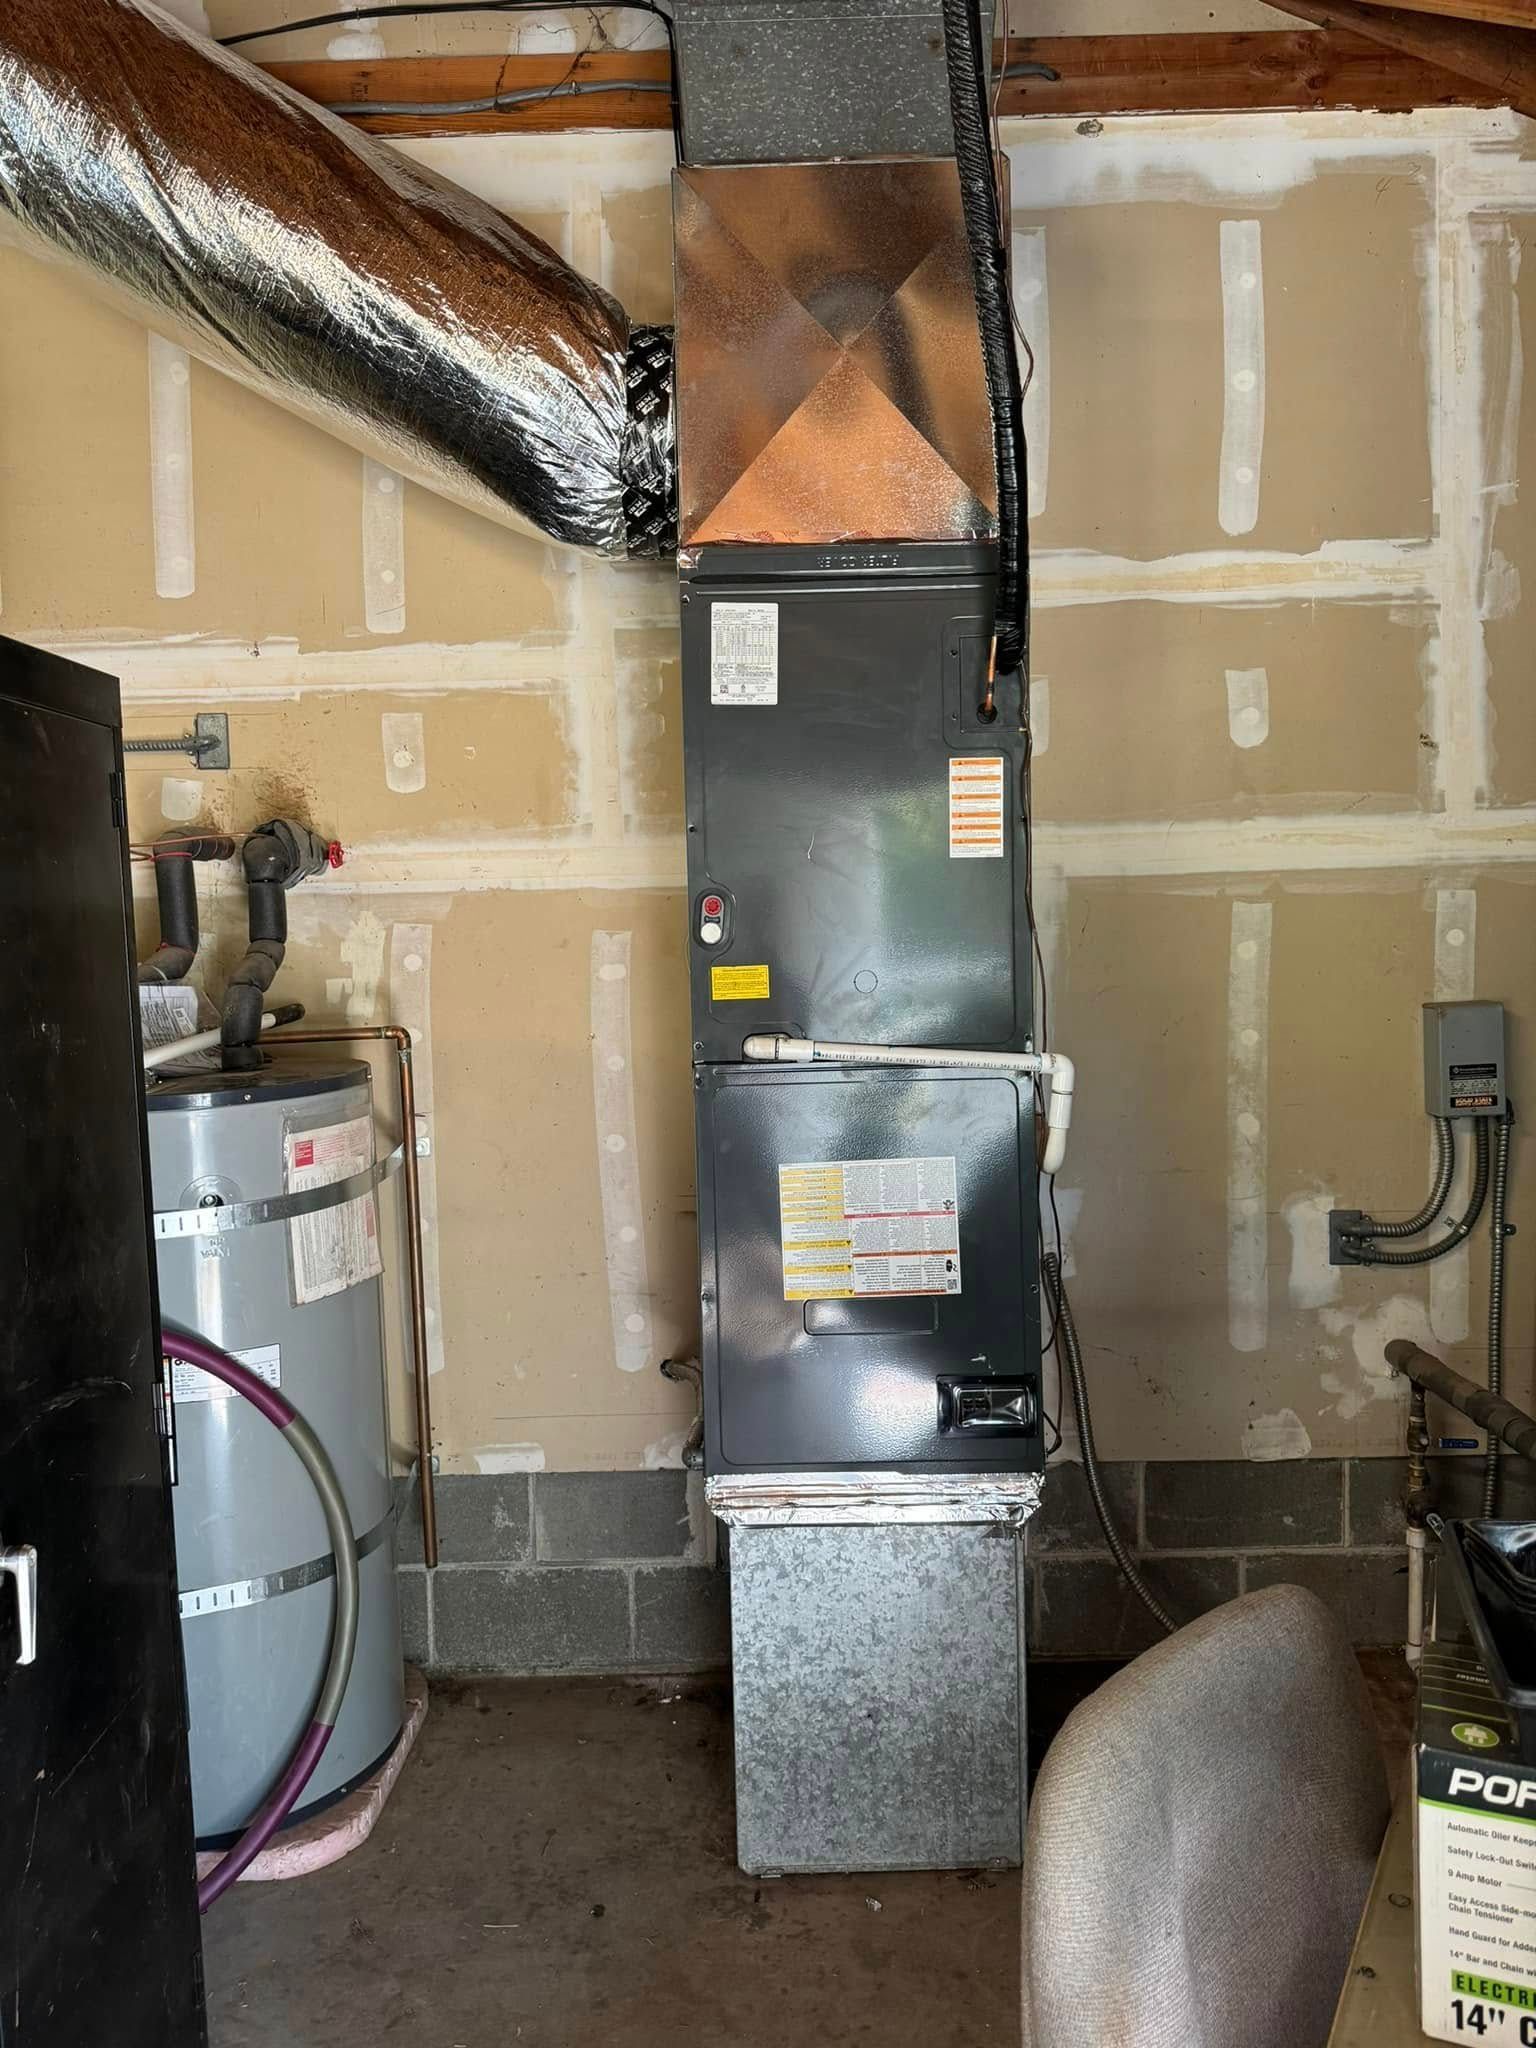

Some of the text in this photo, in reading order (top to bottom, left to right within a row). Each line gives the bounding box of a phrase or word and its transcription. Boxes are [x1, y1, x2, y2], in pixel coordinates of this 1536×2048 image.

[1447, 1822, 1489, 1838] Automatic
[1491, 1828, 1511, 1841] Oiler
[1447, 1846, 1473, 1859] Safety
[1476, 1850, 1513, 1866] Lock-Out
[1447, 1869, 1502, 1887] 9 Amp Motor
[1448, 1892, 1467, 1904] Easy
[1469, 1896, 1499, 1911] Access
[1448, 1902, 1514, 1924] Chain Tensioner
[1449, 1926, 1470, 1938] Hand
[1472, 1931, 1497, 1944] Guard
[1499, 1937, 1510, 1947] for
[1466, 1954, 1480, 1963] Bar
[1482, 1957, 1498, 1968] and
[1501, 1961, 1524, 1974] Chain
[1451, 1999, 1505, 2036] 14"
